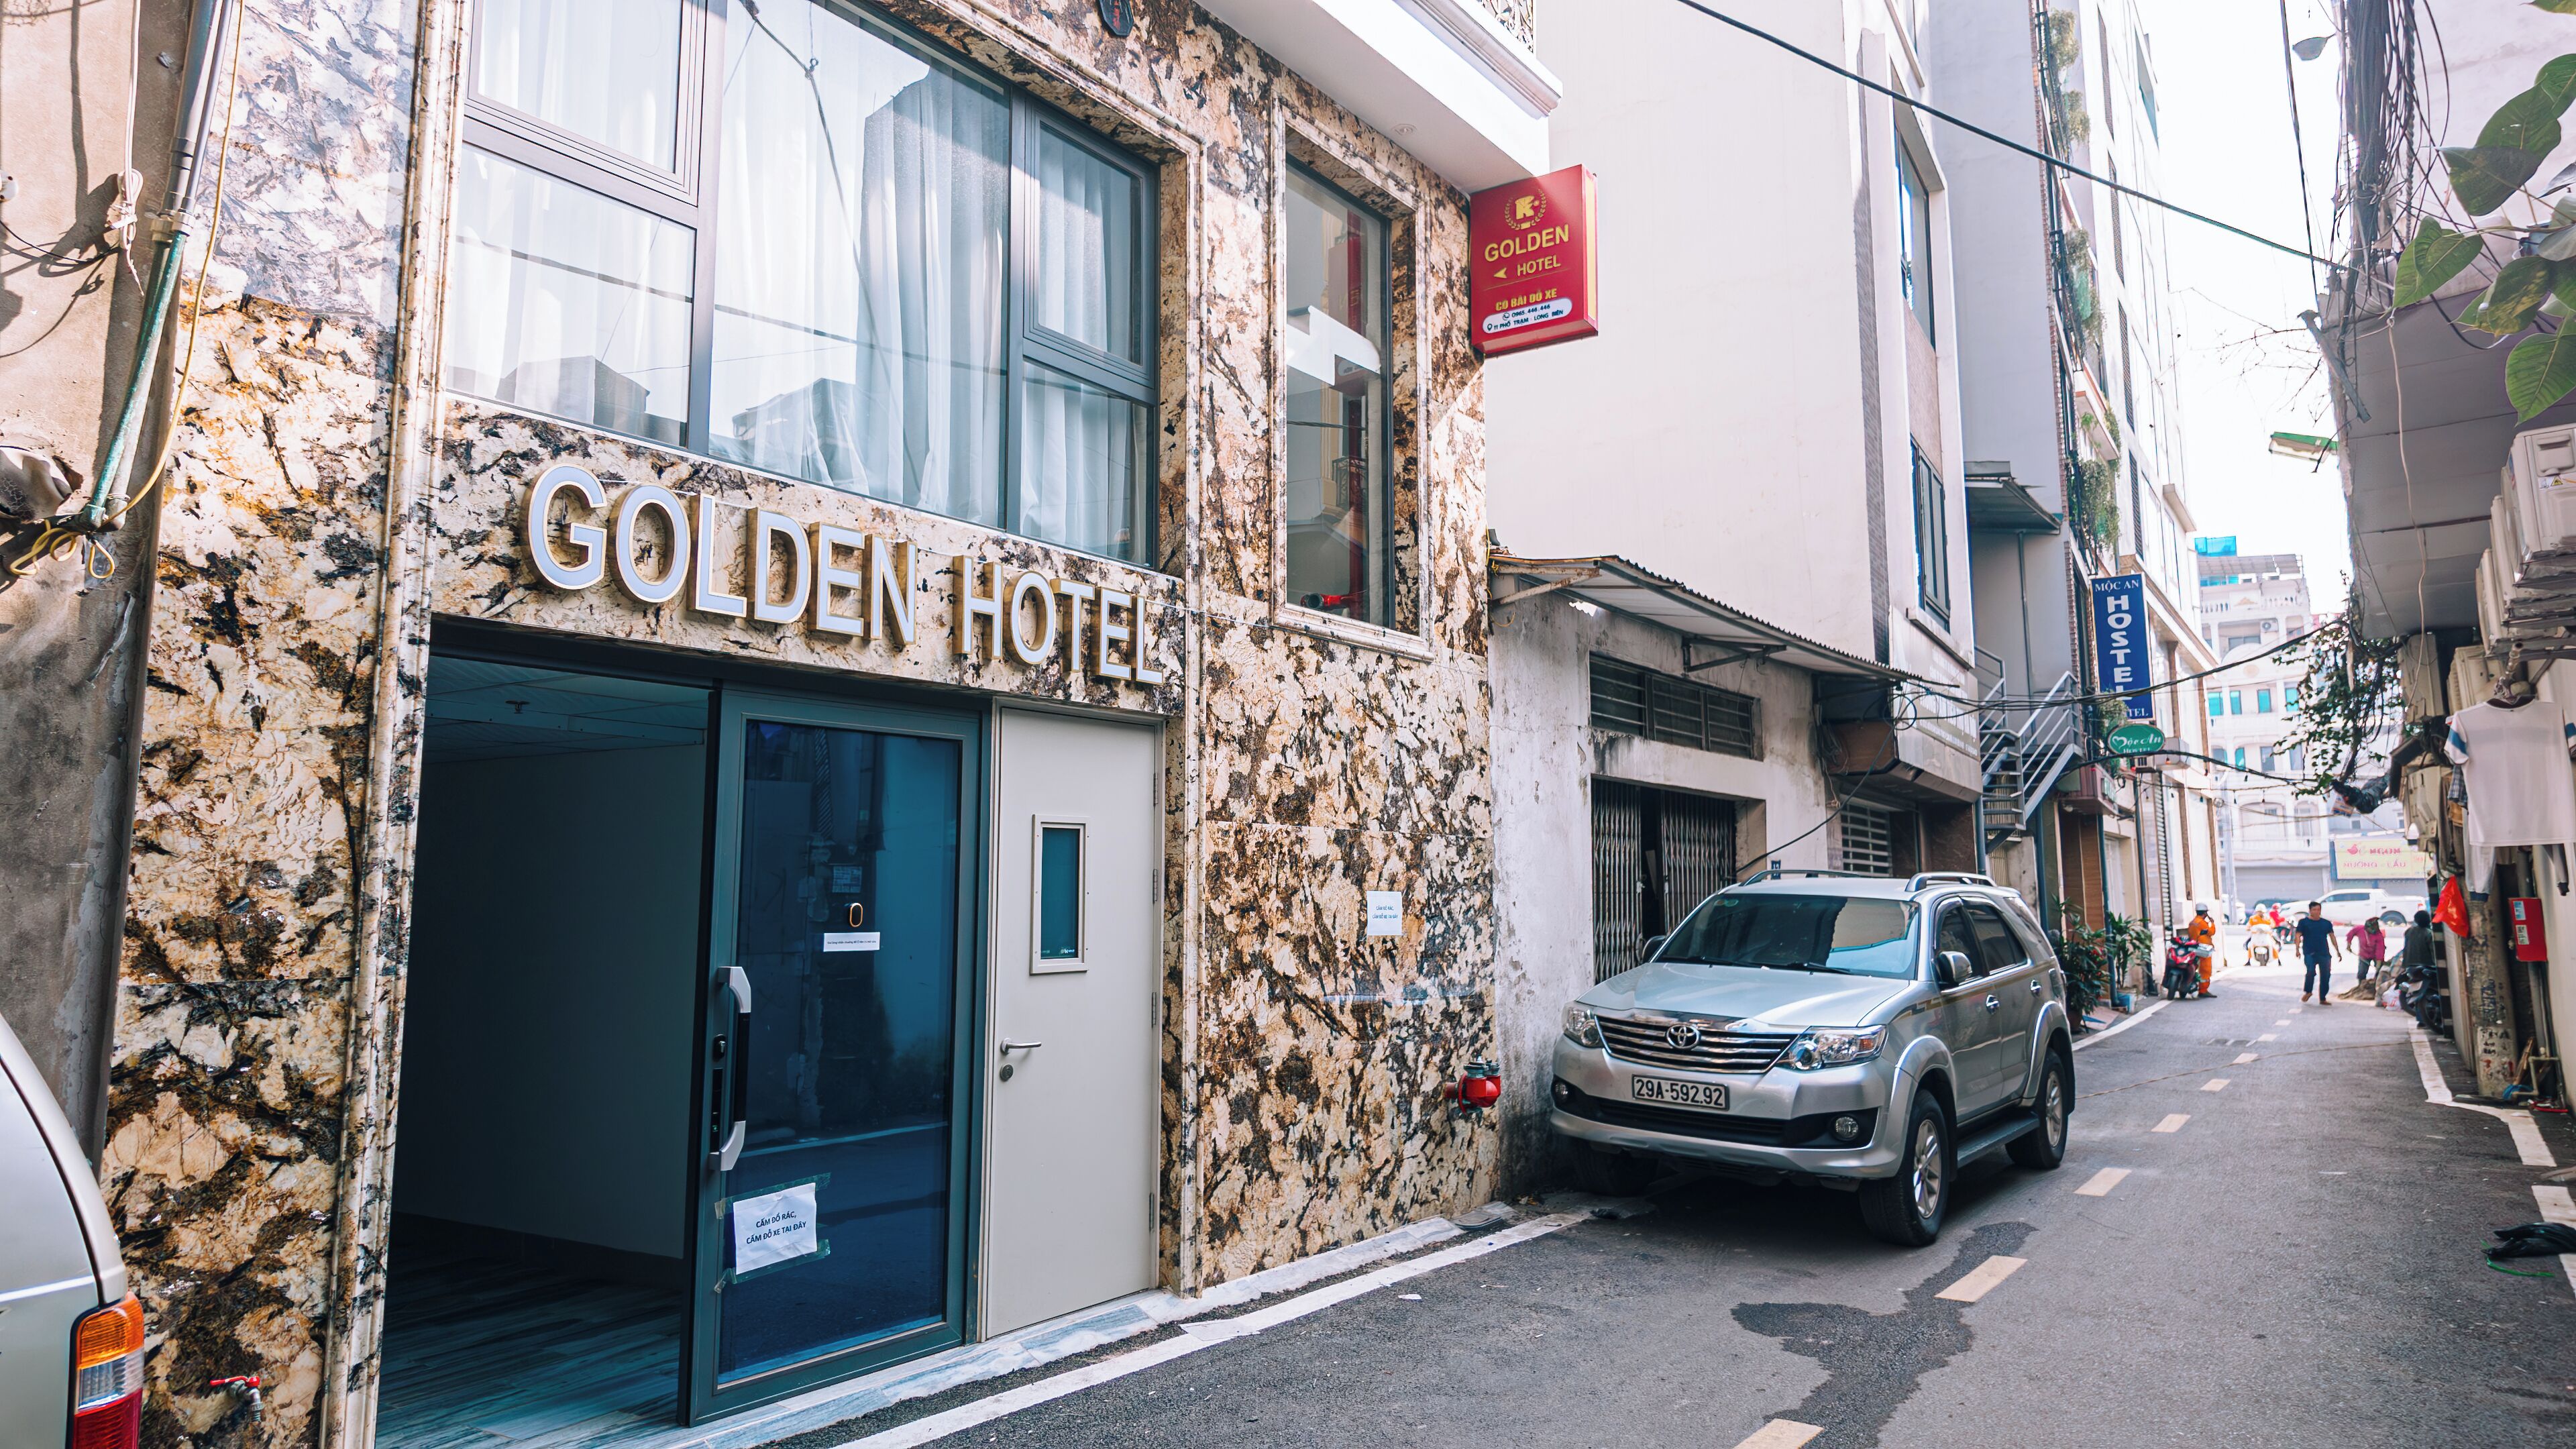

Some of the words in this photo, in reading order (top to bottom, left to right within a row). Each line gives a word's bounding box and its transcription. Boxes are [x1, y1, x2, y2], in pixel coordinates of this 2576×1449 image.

[1485, 224, 1569, 262] GOLDEN
[1516, 254, 1561, 277] HOTEL
[1544, 288, 1557, 300] XE
[1534, 313, 1549, 321] LONG
[522, 463, 918, 645] GOLDEN
[951, 554, 1165, 686] HOTEL
[2095, 580, 2121, 593] MỘC
[2123, 579, 2139, 590] AN
[2106, 595, 2133, 700] HOSTEL
[1635, 1079, 1723, 1107] 29A-592.92
[756, 1217, 771, 1228] CẤM
[782, 1211, 797, 1220] RÁC,
[746, 1233, 762, 1244] CẤM
[773, 1228, 781, 1236] XE
[782, 1225, 792, 1234] TẠI
[793, 1221, 807, 1231] ĐÂY
